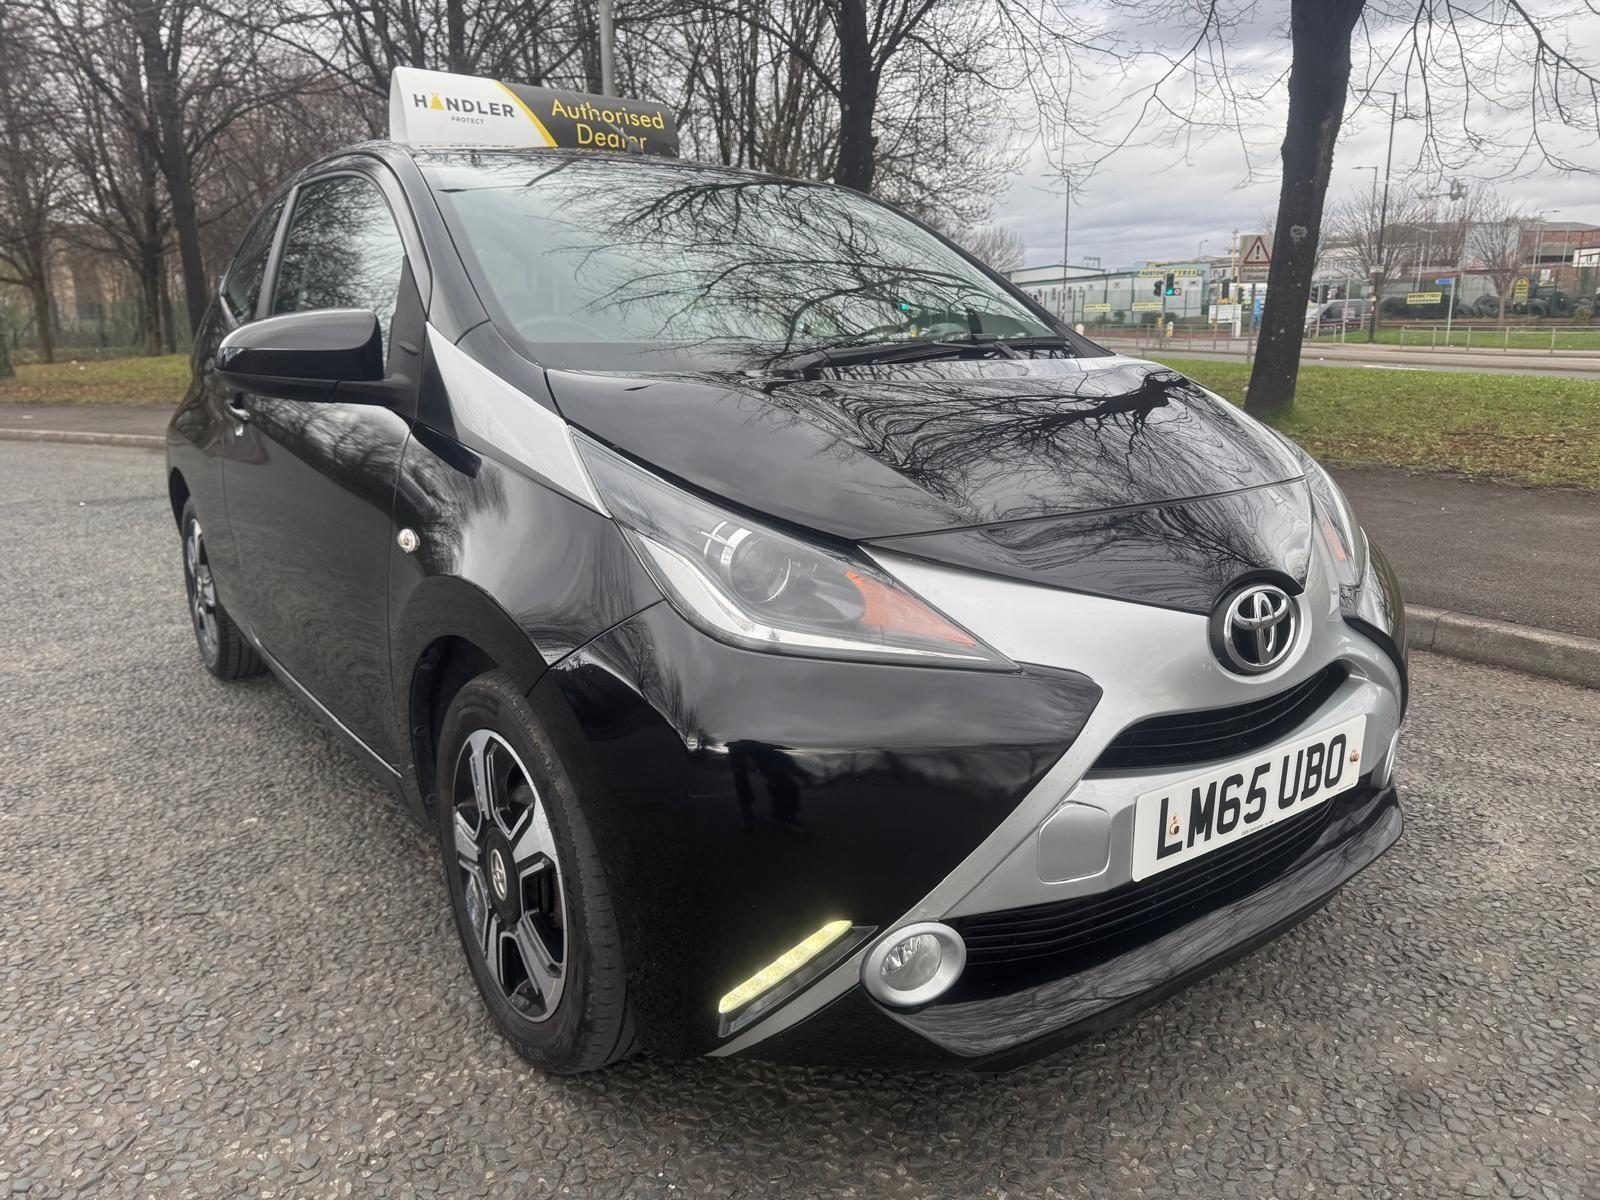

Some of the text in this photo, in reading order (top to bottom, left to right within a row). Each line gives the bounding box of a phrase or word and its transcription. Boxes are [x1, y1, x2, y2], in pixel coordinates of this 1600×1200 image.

[451, 115, 484, 125] PROTECT
[551, 98, 665, 130] Authorised
[1156, 732, 1347, 861] LM65 UBO
